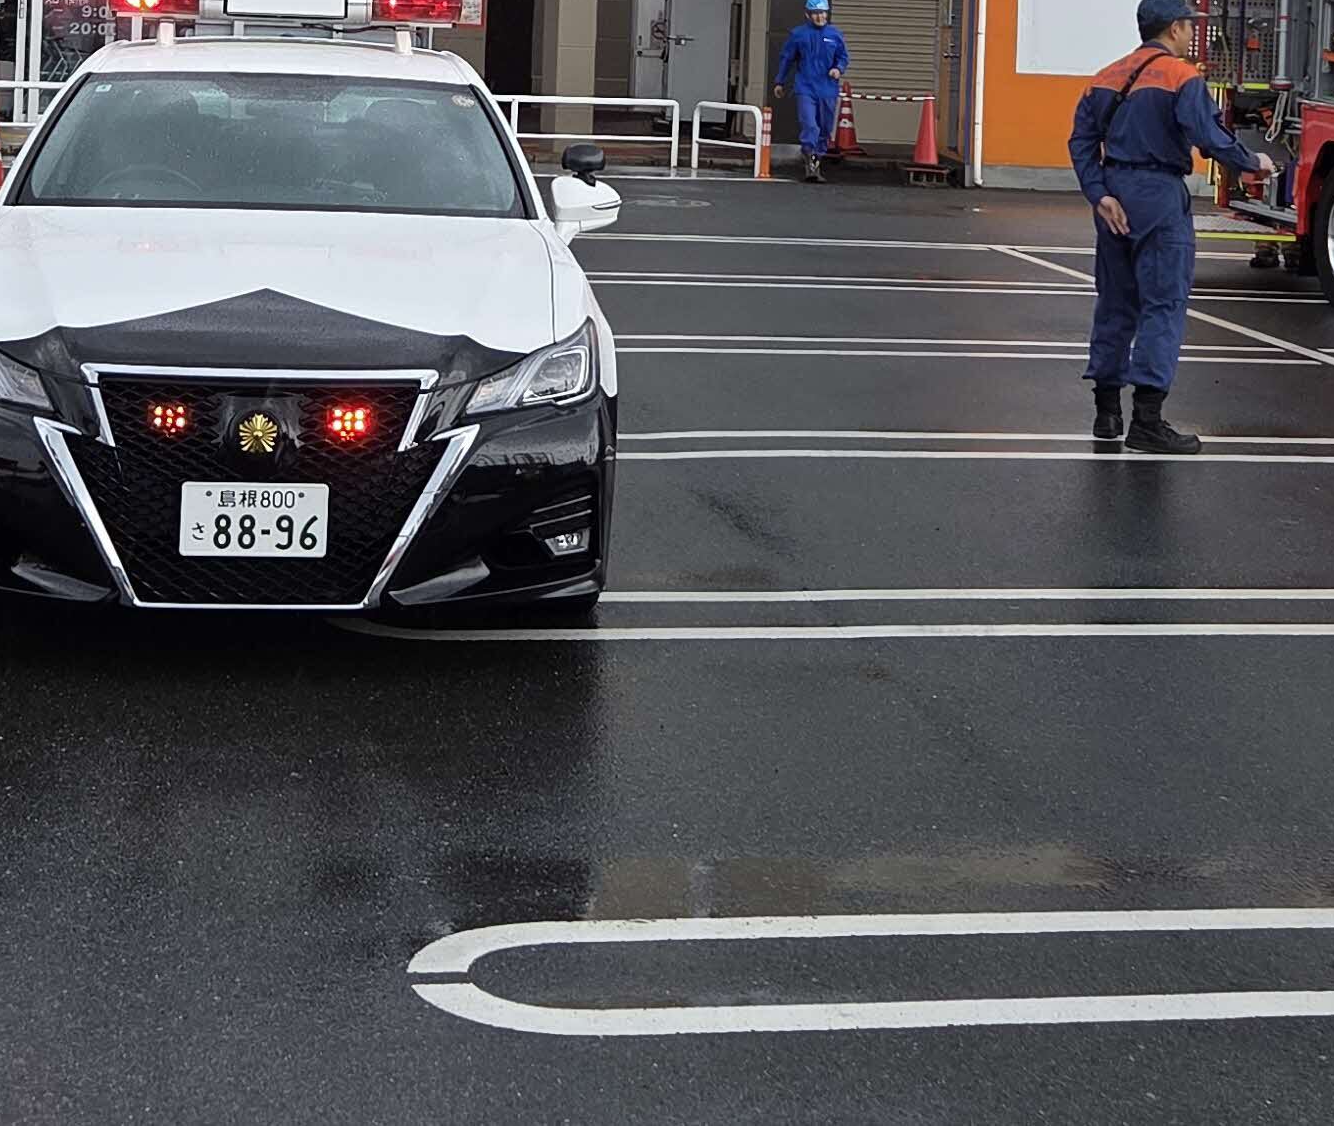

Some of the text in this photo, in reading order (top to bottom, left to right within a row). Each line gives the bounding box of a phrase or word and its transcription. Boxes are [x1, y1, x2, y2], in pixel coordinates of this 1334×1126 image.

[217, 489, 296, 509] 島根800
[191, 513, 319, 551] さ 88-96
